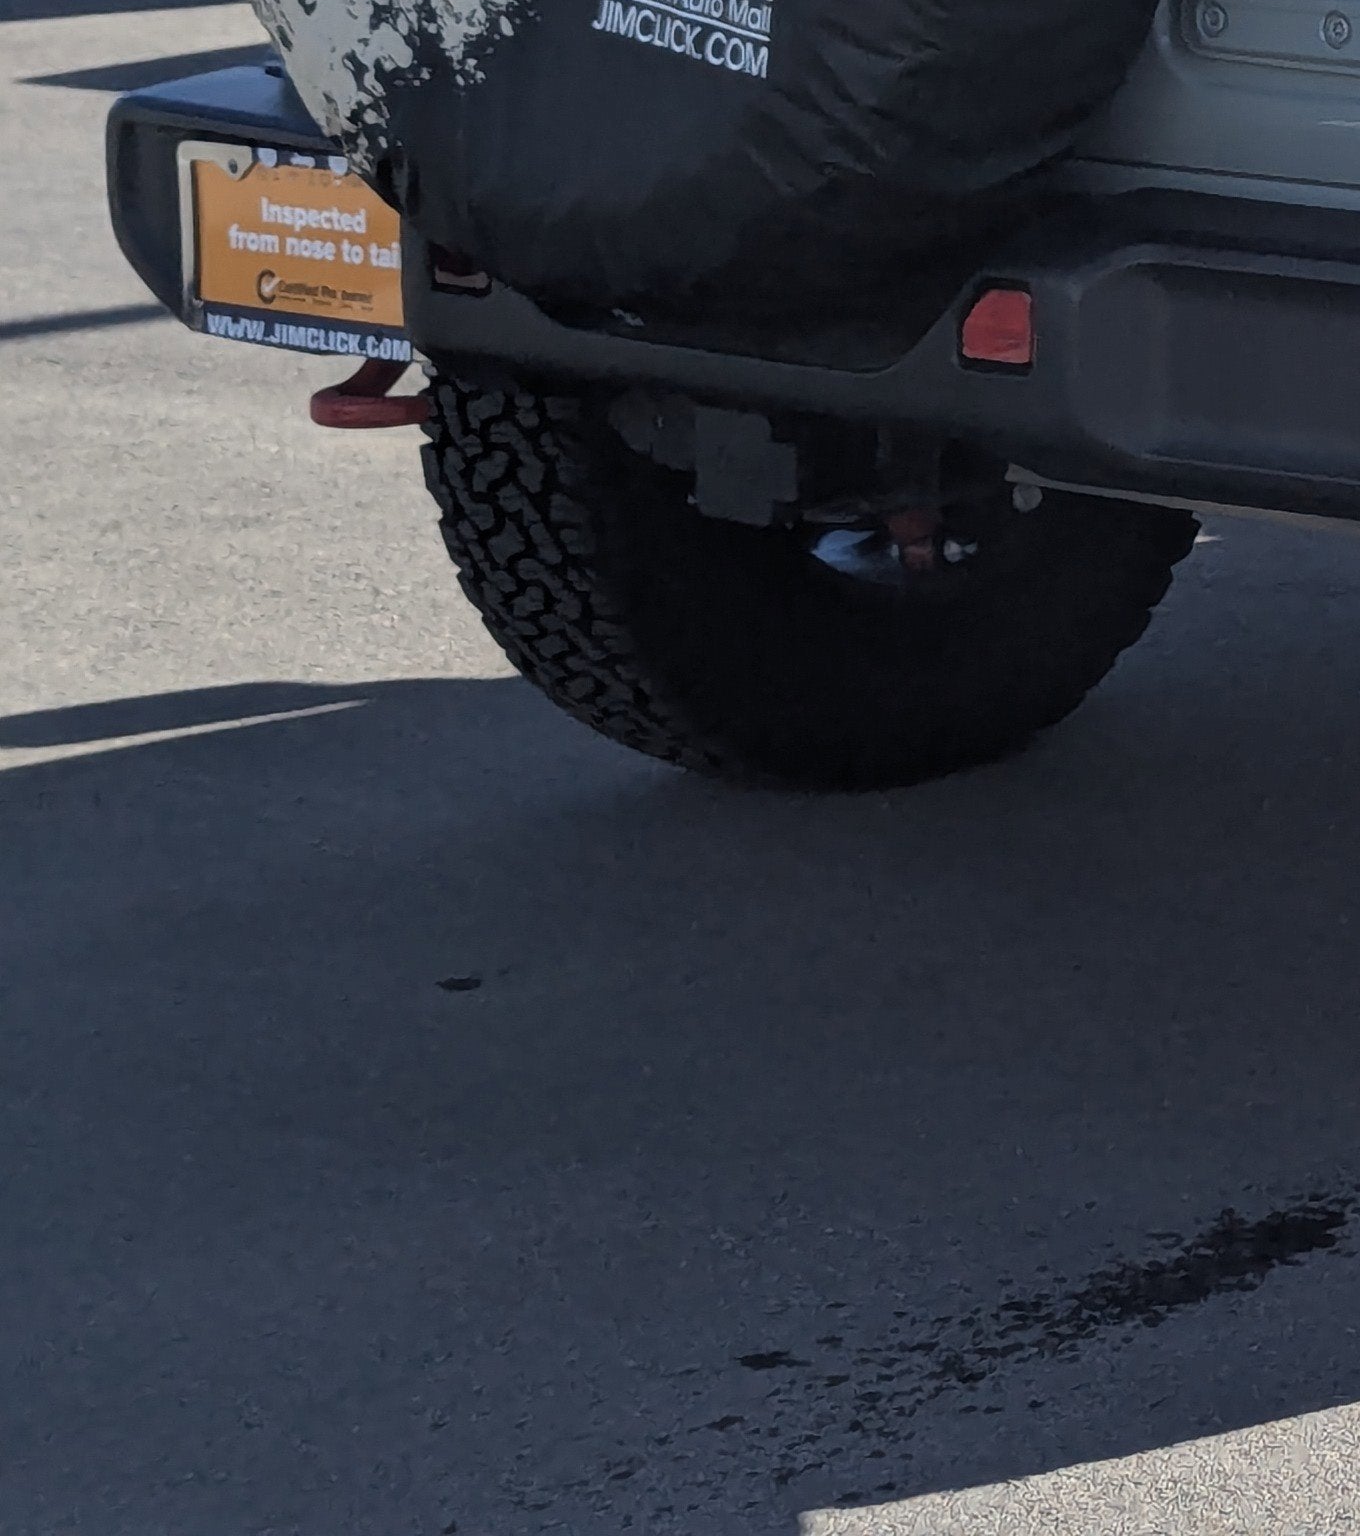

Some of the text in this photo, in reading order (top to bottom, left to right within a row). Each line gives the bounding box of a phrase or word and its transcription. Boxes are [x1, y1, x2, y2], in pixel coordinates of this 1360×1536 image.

[592, 0, 770, 79] JIMCLICK.COM
[259, 195, 367, 234] Inspected
[228, 222, 401, 270] from nose to tai
[206, 311, 412, 362] WWW.JIMCLICK.COM
